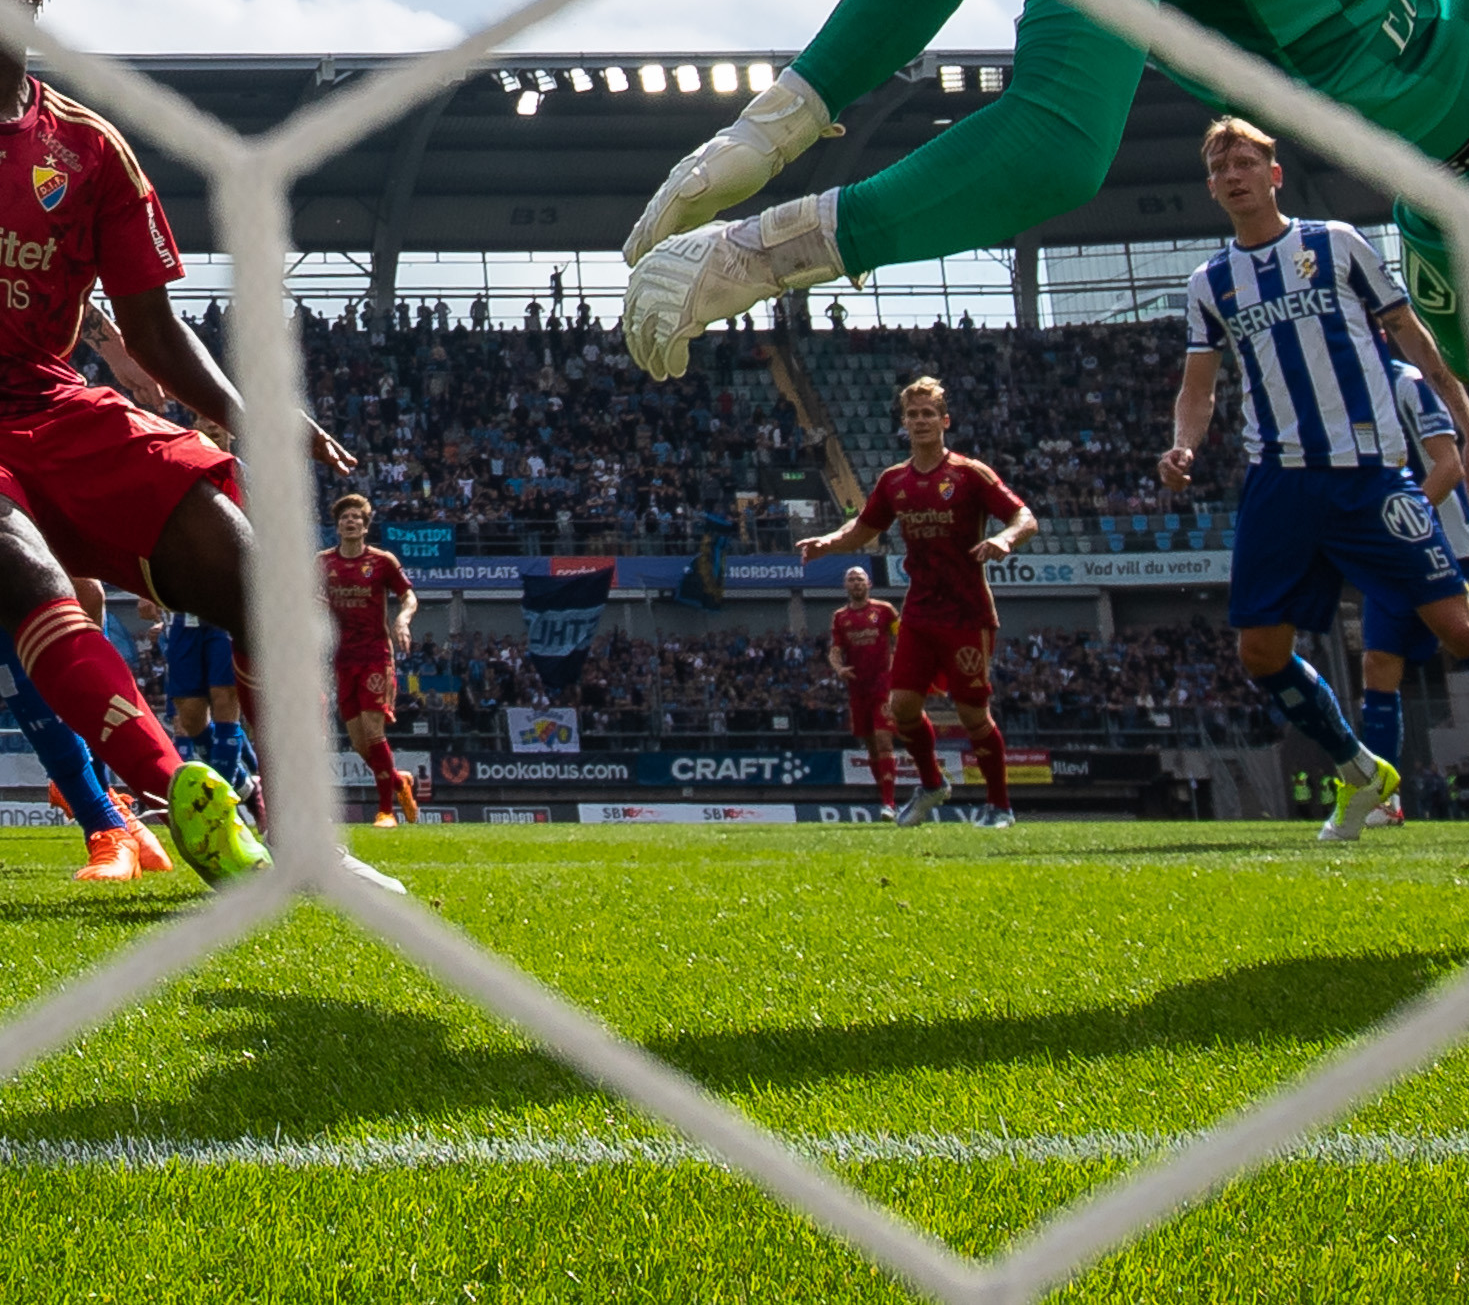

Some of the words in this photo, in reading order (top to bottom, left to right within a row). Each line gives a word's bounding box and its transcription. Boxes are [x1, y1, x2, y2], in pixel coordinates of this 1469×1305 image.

[1227, 288, 1337, 342] SERNEKE
[1386, 496, 1431, 539] MG
[1084, 561, 1114, 577] Vad
[1116, 559, 1141, 576] vill
[1145, 560, 1166, 576] du
[1167, 558, 1212, 574] veta?
[1424, 545, 1451, 570] 15
[477, 565, 520, 579] PLATS
[729, 565, 804, 579] NORDSTAN
[988, 559, 1074, 583] nfo.se
[476, 762, 629, 780] bookabus.com
[671, 757, 780, 780] CRAFT
